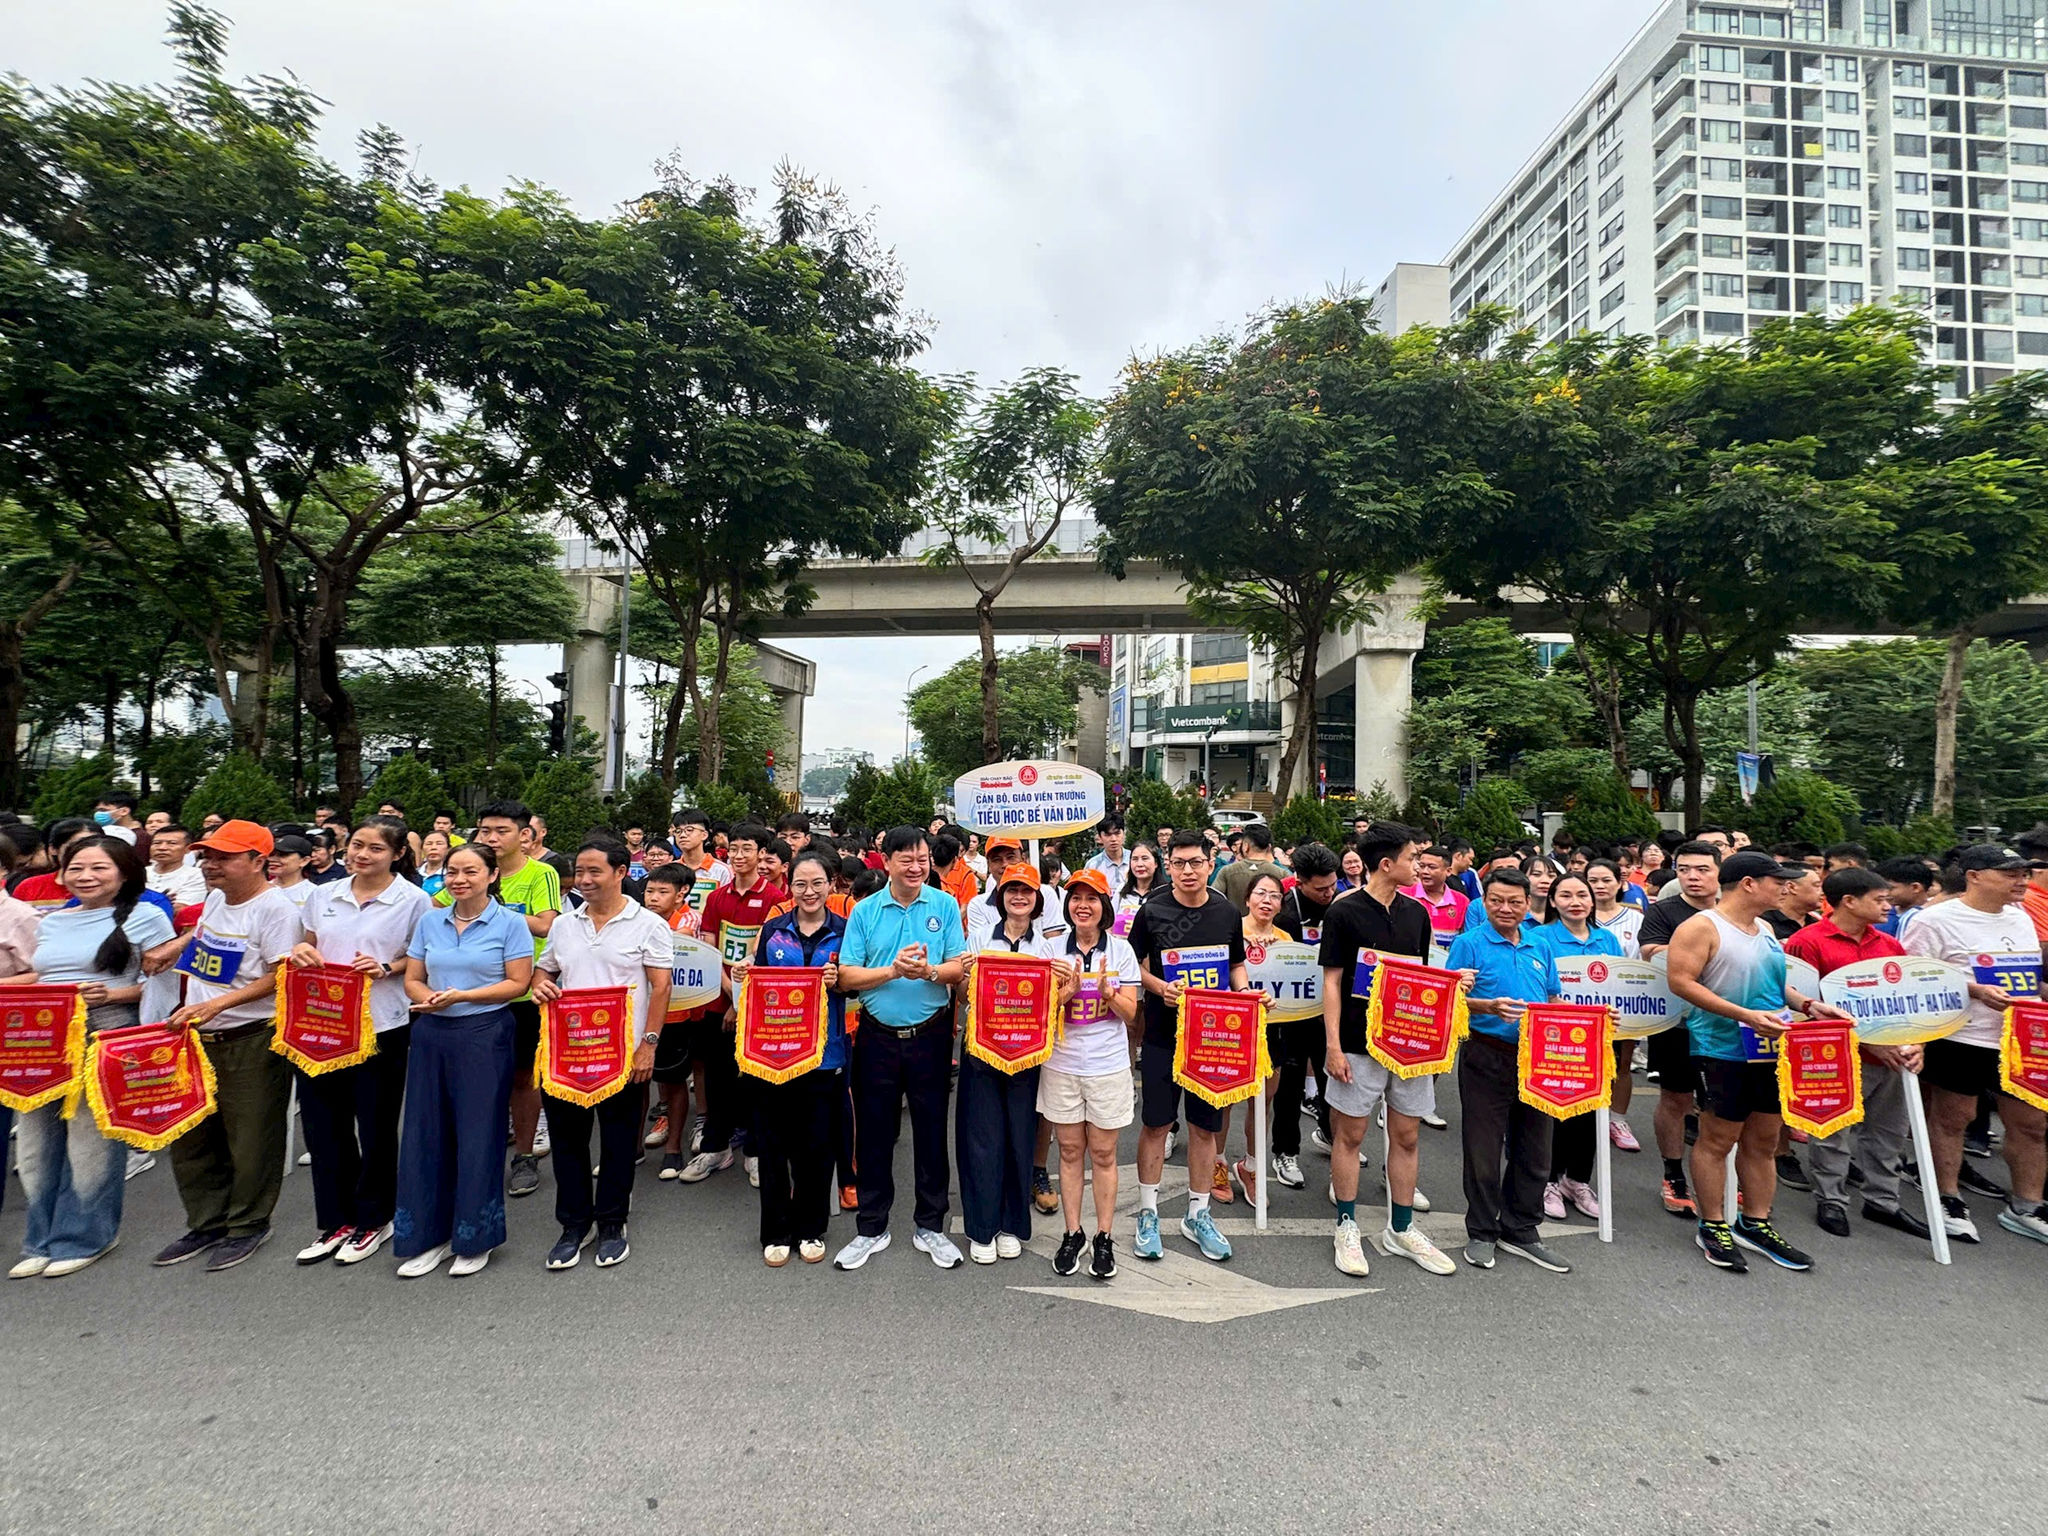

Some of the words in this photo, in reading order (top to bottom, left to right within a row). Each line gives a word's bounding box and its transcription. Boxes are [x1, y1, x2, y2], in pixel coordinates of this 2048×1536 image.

[1171, 717, 1228, 728] Vietcombank
[976, 792, 994, 804] CÁN
[1012, 790, 1032, 802] GIÁO
[1034, 790, 1053, 802] VIÊN
[1055, 789, 1086, 800] TRƯỜNG
[977, 805, 1000, 825] TIỂU
[1004, 809, 1025, 827] HỌC
[1028, 804, 1041, 823] BẾ
[1043, 804, 1063, 822] VĂN
[1066, 803, 1087, 821] ĐÀN
[725, 939, 747, 961] 63
[688, 968, 703, 987] ĐA
[1177, 968, 1218, 988] 356
[1271, 981, 1283, 999] Y
[1291, 975, 1316, 999] TẾ
[1994, 972, 2038, 991] 333
[1615, 993, 1666, 1015] PHƯỜNG
[1856, 996, 1870, 1022] DỰ
[1871, 994, 1885, 1017] ÁN
[1906, 993, 1918, 1014] TƯ
[1925, 993, 1939, 1016] HẠ
[1939, 986, 1963, 1011] TẦNG
